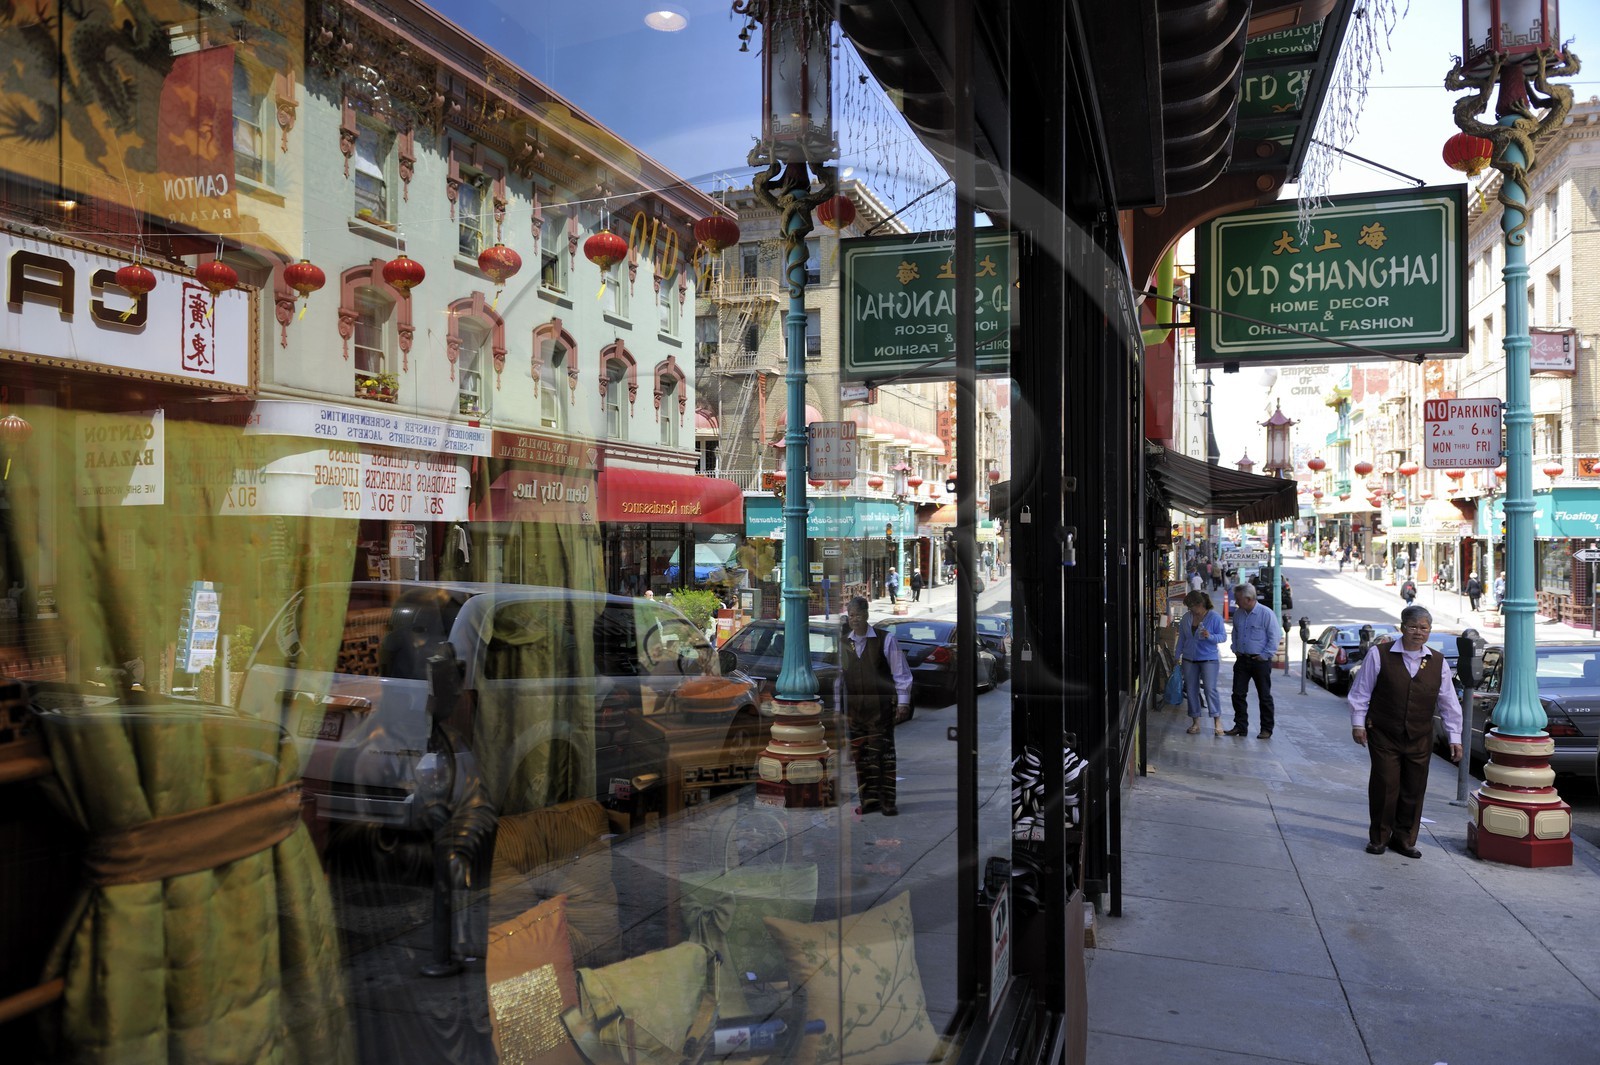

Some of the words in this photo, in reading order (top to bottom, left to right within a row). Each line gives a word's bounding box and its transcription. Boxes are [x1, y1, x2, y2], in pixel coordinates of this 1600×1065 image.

[1272, 221, 1388, 256] 大上海
[1226, 265, 1280, 297] OLD
[1289, 253, 1438, 294] SHANGHAI
[1270, 299, 1319, 313] HOME
[1329, 296, 1389, 310] DECOR
[1323, 310, 1334, 321] &
[1248, 321, 1329, 336] ORIENTAL
[1340, 317, 1414, 332] FASHION
[1280, 366, 1330, 376] EMPRESS
[1299, 376, 1312, 385] OF
[1291, 386, 1321, 395] CHINA
[1427, 401, 1447, 420] NO
[1450, 404, 1498, 418] PARKING
[1432, 424, 1440, 436] 2
[1471, 423, 1478, 435] 6
[1433, 442, 1451, 453] MON
[1476, 441, 1491, 452] FRI
[1459, 458, 1495, 466] CLEANING
[1555, 511, 1598, 523] Floating
